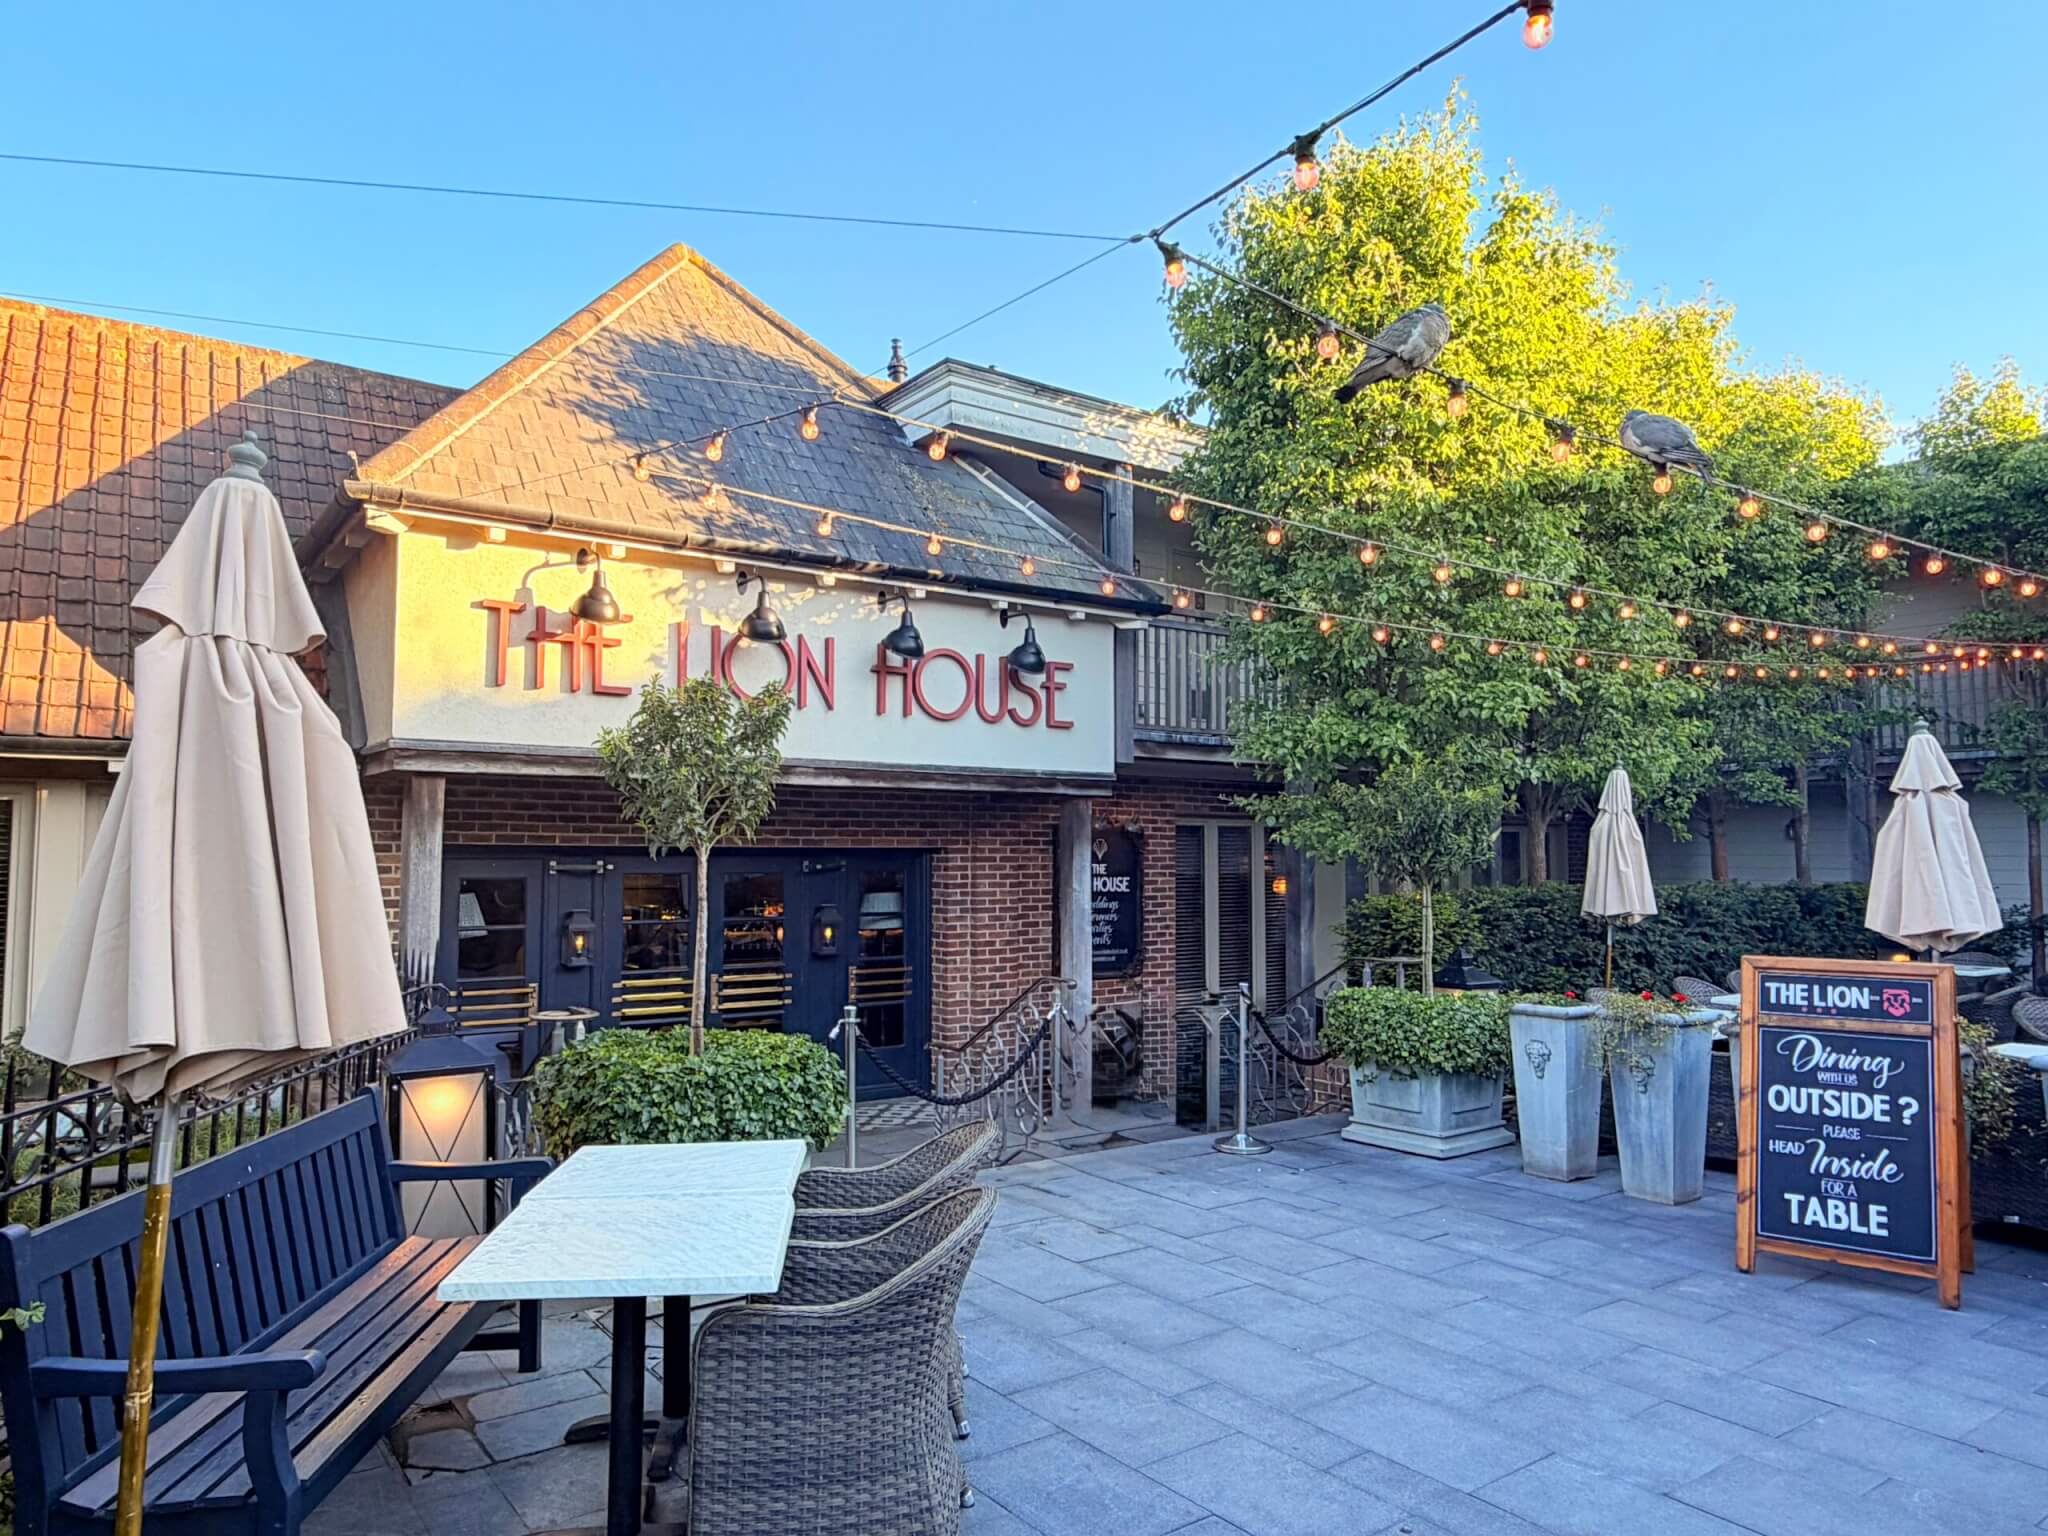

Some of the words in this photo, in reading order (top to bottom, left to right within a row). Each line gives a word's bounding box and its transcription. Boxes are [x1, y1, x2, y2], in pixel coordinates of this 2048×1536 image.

[481, 599, 633, 696] THE
[870, 642, 1074, 729] HOUSE
[1093, 876, 1130, 892] HOUSE
[1764, 982, 1808, 1006] THE
[1813, 984, 1870, 1010] LION
[1776, 1034, 1905, 1089] Dining
[1817, 1071, 1843, 1083] WITH
[1844, 1073, 1858, 1084] US
[1768, 1084, 1891, 1122] OUTSIDE
[1822, 1124, 1861, 1140] PLEASE
[1769, 1139, 1805, 1155] HEAD
[1805, 1138, 1904, 1183] Inside
[1821, 1180, 1844, 1196] FOR
[1847, 1183, 1858, 1197] A
[1784, 1193, 1889, 1237] TABLE
